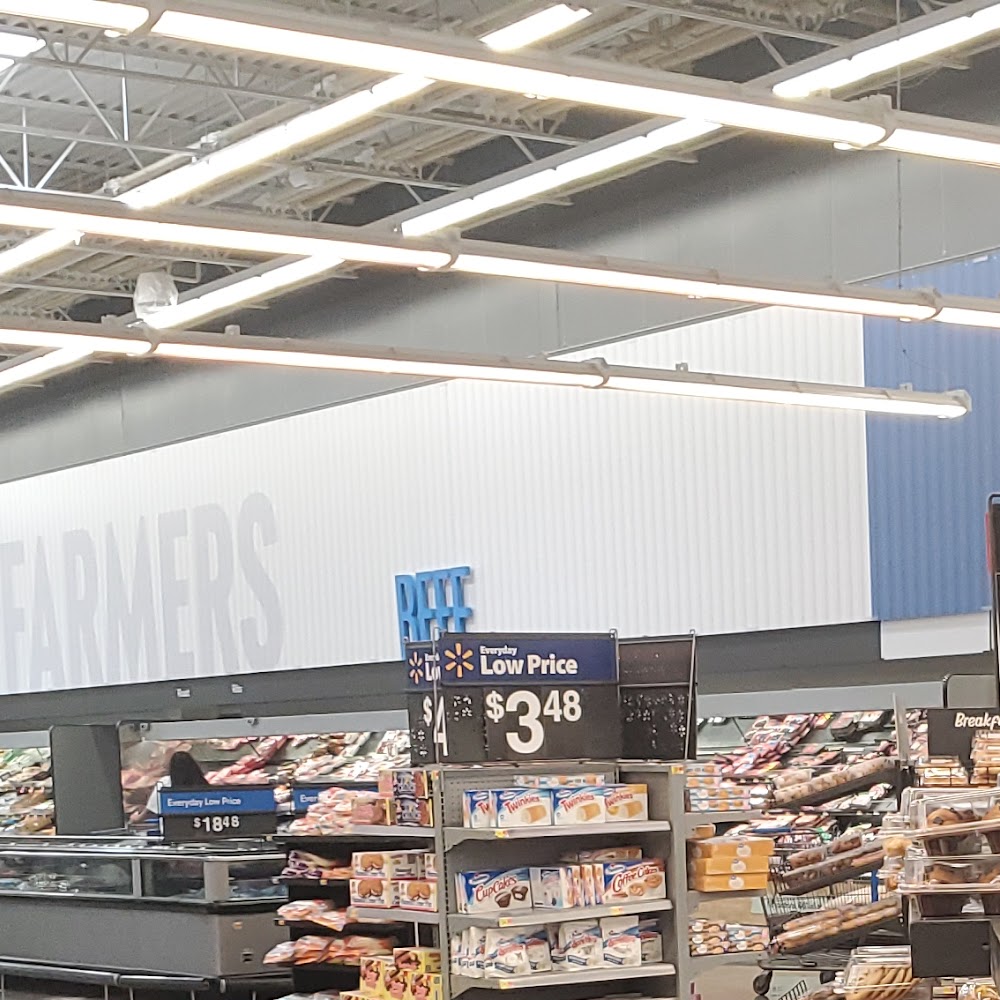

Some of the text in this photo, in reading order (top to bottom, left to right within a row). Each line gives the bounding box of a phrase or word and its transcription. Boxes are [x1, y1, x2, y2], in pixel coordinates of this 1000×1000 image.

[0, 491, 285, 692] FARMERS
[479, 644, 518, 657] Everyday
[479, 654, 579, 676] Low Price
[166, 796, 242, 809] Everyday Low Price
